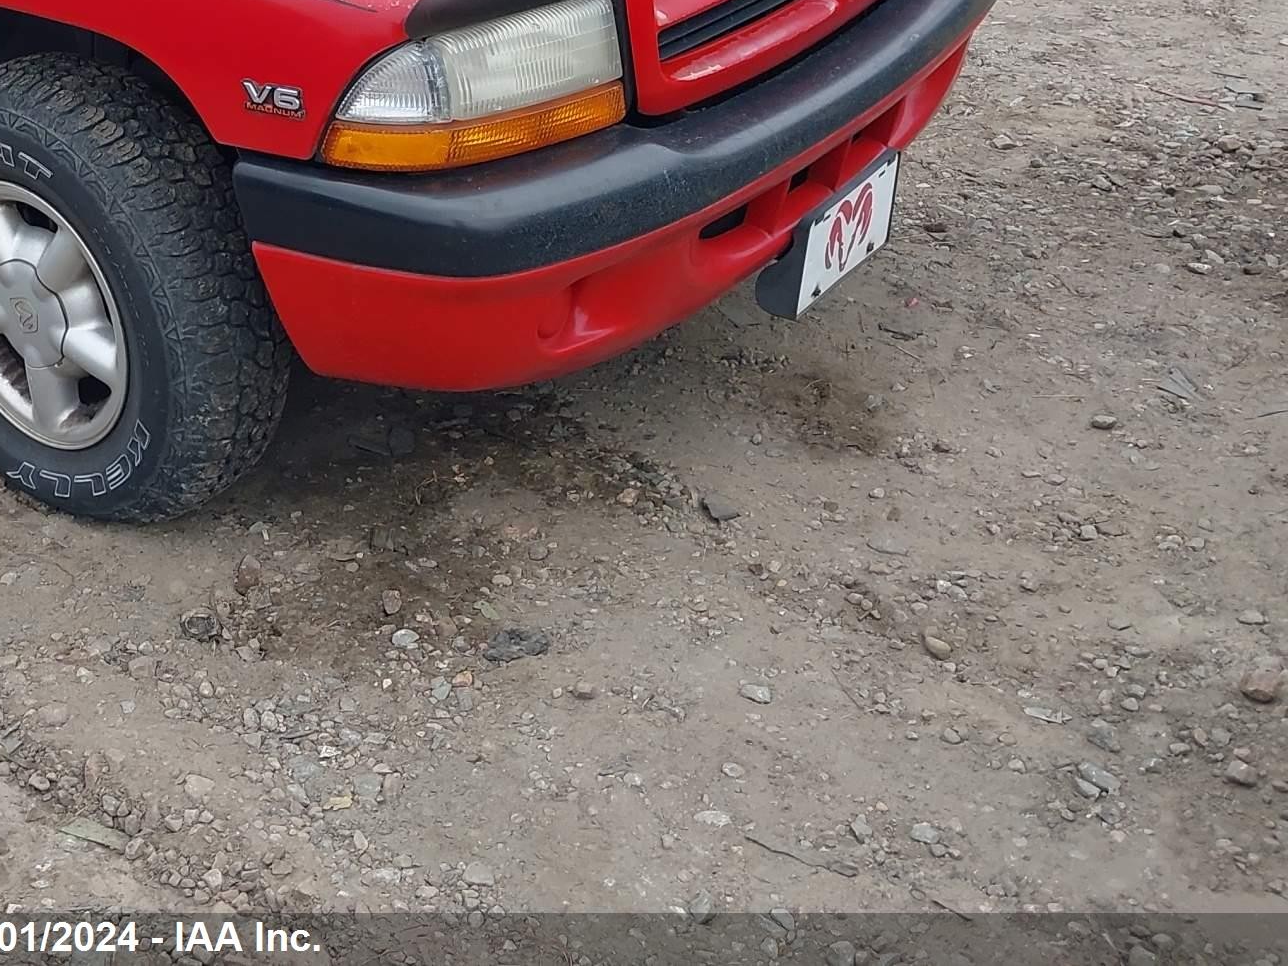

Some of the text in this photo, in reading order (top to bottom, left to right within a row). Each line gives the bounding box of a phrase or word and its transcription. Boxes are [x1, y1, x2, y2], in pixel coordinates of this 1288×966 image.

[240, 79, 301, 110] V6
[245, 101, 304, 120] MAGNUM
[6, 418, 151, 498] KELLY
